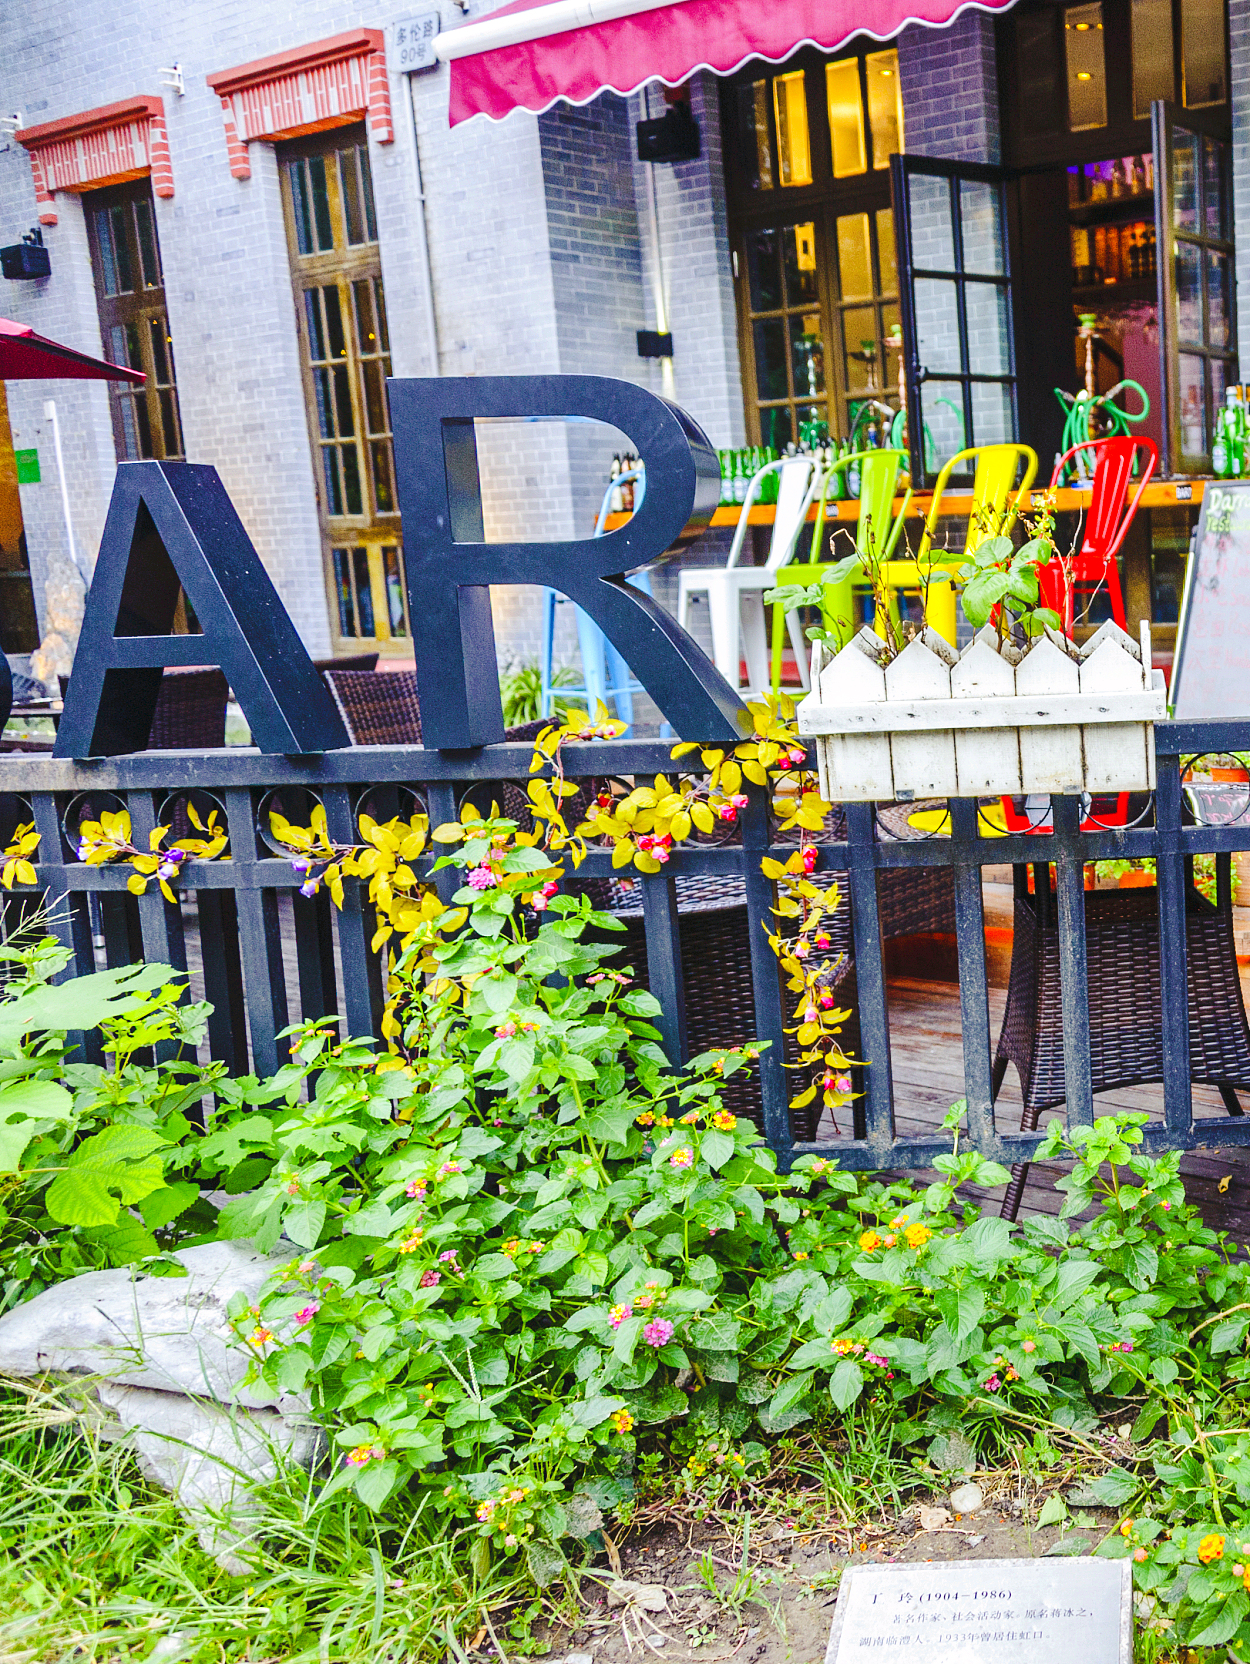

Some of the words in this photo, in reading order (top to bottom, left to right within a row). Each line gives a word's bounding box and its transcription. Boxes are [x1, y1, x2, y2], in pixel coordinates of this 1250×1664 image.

[396, 20, 433, 46] 多伦路
[400, 43, 427, 64] 90号
[0, 373, 755, 757] AR
